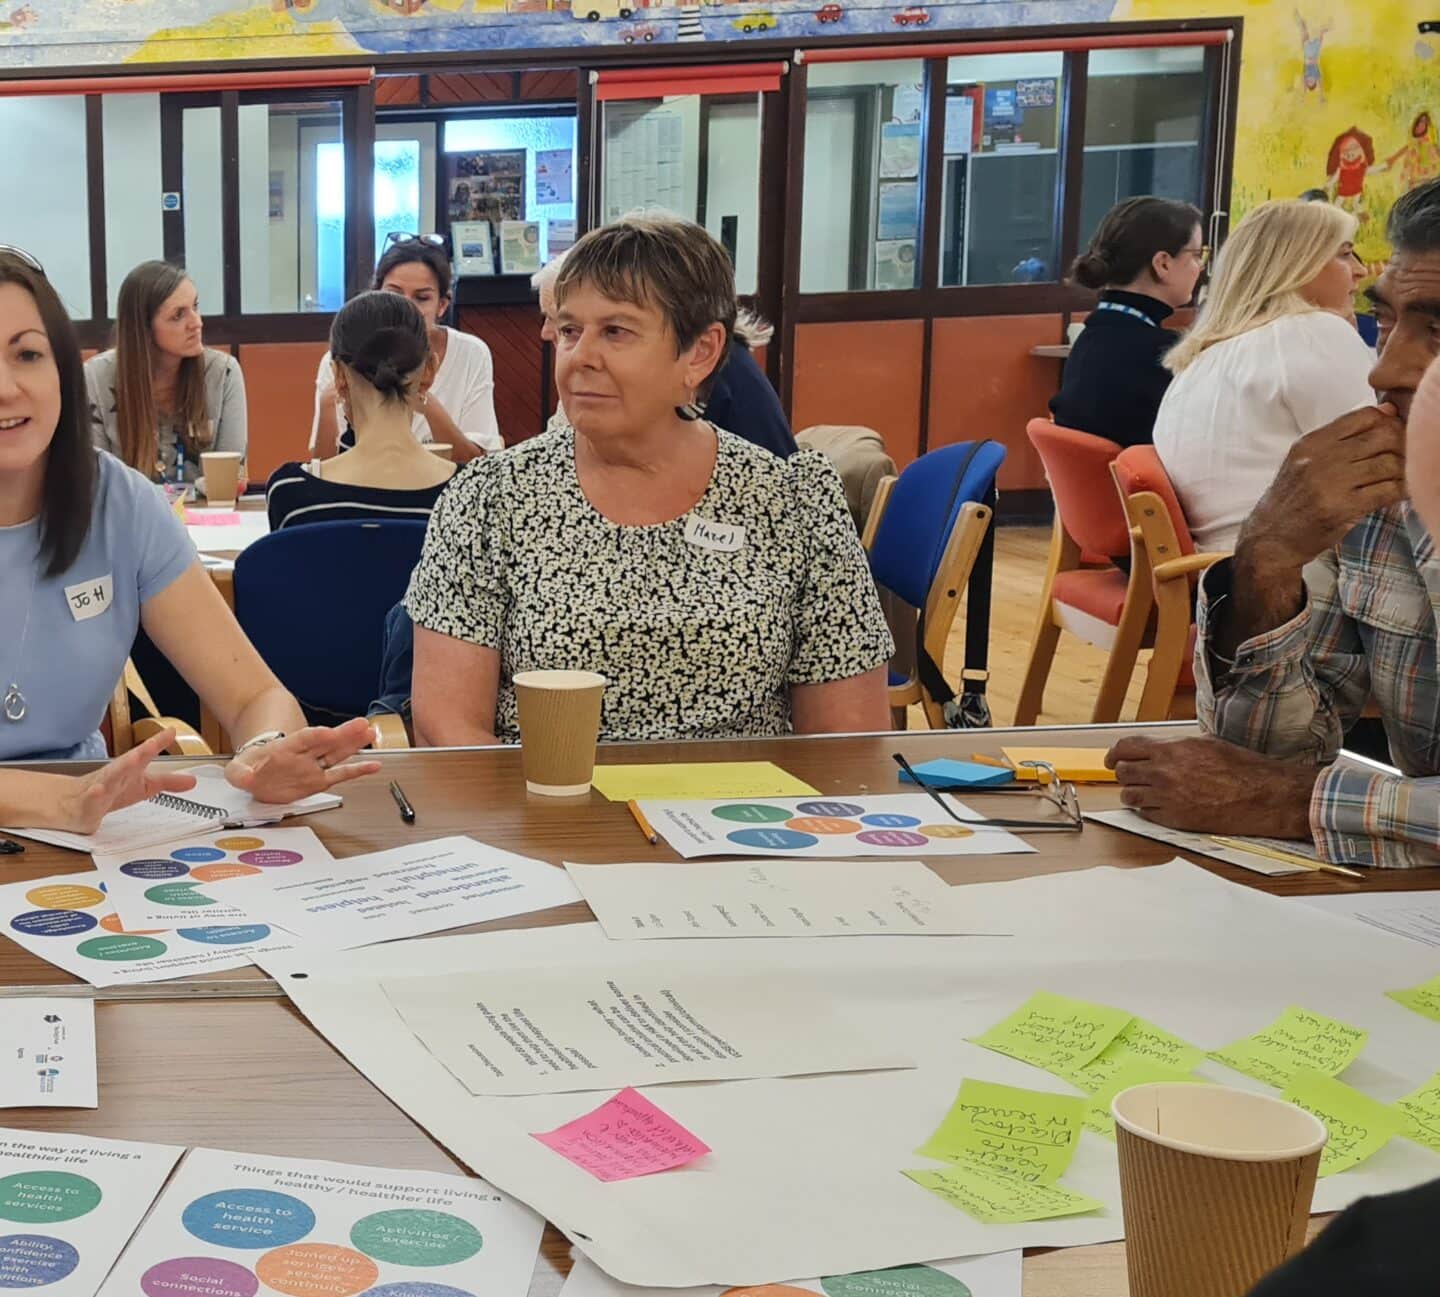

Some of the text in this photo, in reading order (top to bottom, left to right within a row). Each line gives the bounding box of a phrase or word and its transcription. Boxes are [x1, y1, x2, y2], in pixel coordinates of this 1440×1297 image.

[694, 523, 734, 544] Hazel
[71, 585, 104, 608] Jo H
[396, 862, 479, 884] unhelpful
[416, 874, 512, 899] abandoned
[305, 895, 385, 913] helpless
[12, 1141, 35, 1151] the
[39, 1146, 66, 1157] way
[70, 1148, 88, 1156] of
[90, 1149, 131, 1160] living
[65, 1154, 88, 1164] life
[13, 1182, 80, 1195] Access to
[233, 1163, 283, 1177] Things
[287, 1171, 319, 1181] that
[323, 1175, 372, 1187] would
[375, 1184, 441, 1194] support
[443, 1189, 488, 1201] living
[17, 1191, 62, 1202] health
[273, 1178, 335, 1193] healthy
[349, 1189, 421, 1203] healthier
[426, 1197, 453, 1206] life
[4, 1200, 63, 1212] services
[215, 1201, 293, 1217] Access to
[222, 1212, 275, 1226] health
[213, 1223, 273, 1236] service
[375, 1225, 449, 1240] Activities
[382, 1236, 447, 1249] exercise
[3, 1255, 57, 1267] exercise
[287, 1249, 360, 1265] Joined up
[1, 1263, 29, 1273] with
[180, 1273, 225, 1285] Social
[270, 1278, 348, 1293] continuity
[152, 1279, 241, 1297] connections
